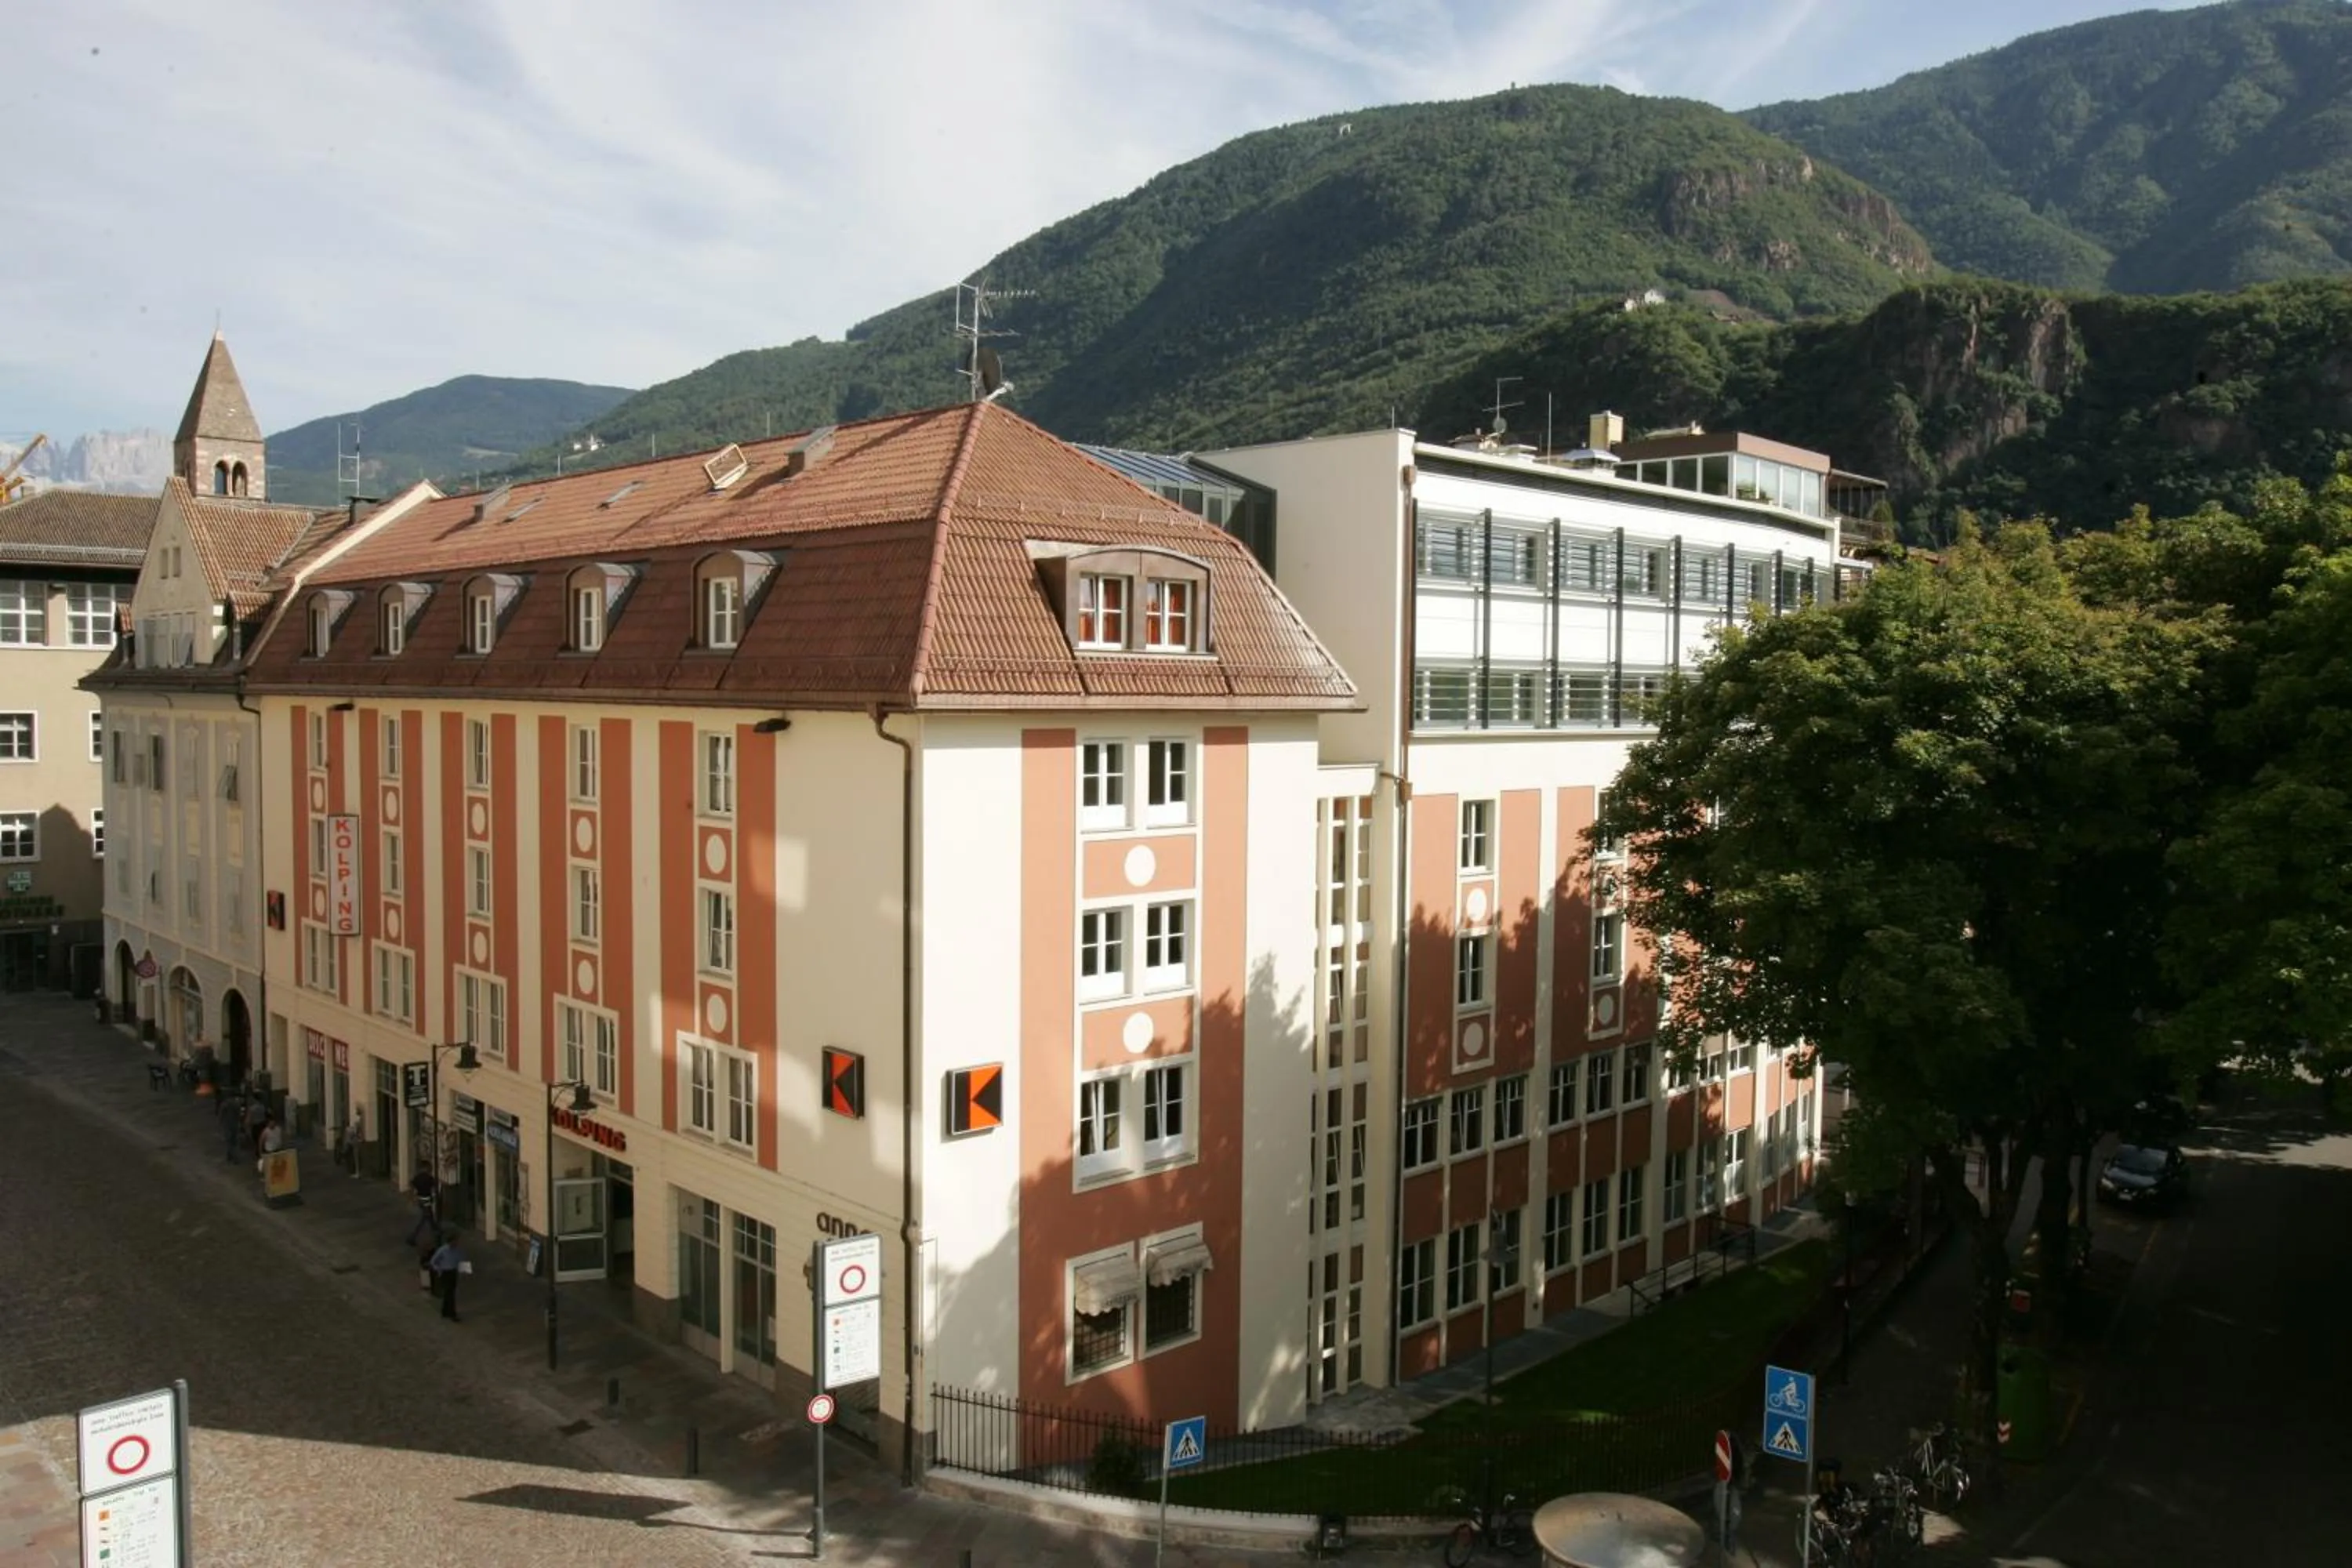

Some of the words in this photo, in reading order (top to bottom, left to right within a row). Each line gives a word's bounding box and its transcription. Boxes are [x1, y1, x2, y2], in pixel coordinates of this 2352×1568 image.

[336, 819, 352, 931] KOLPING
[550, 1107, 626, 1152] KOLPING
[816, 1212, 872, 1239] ann
